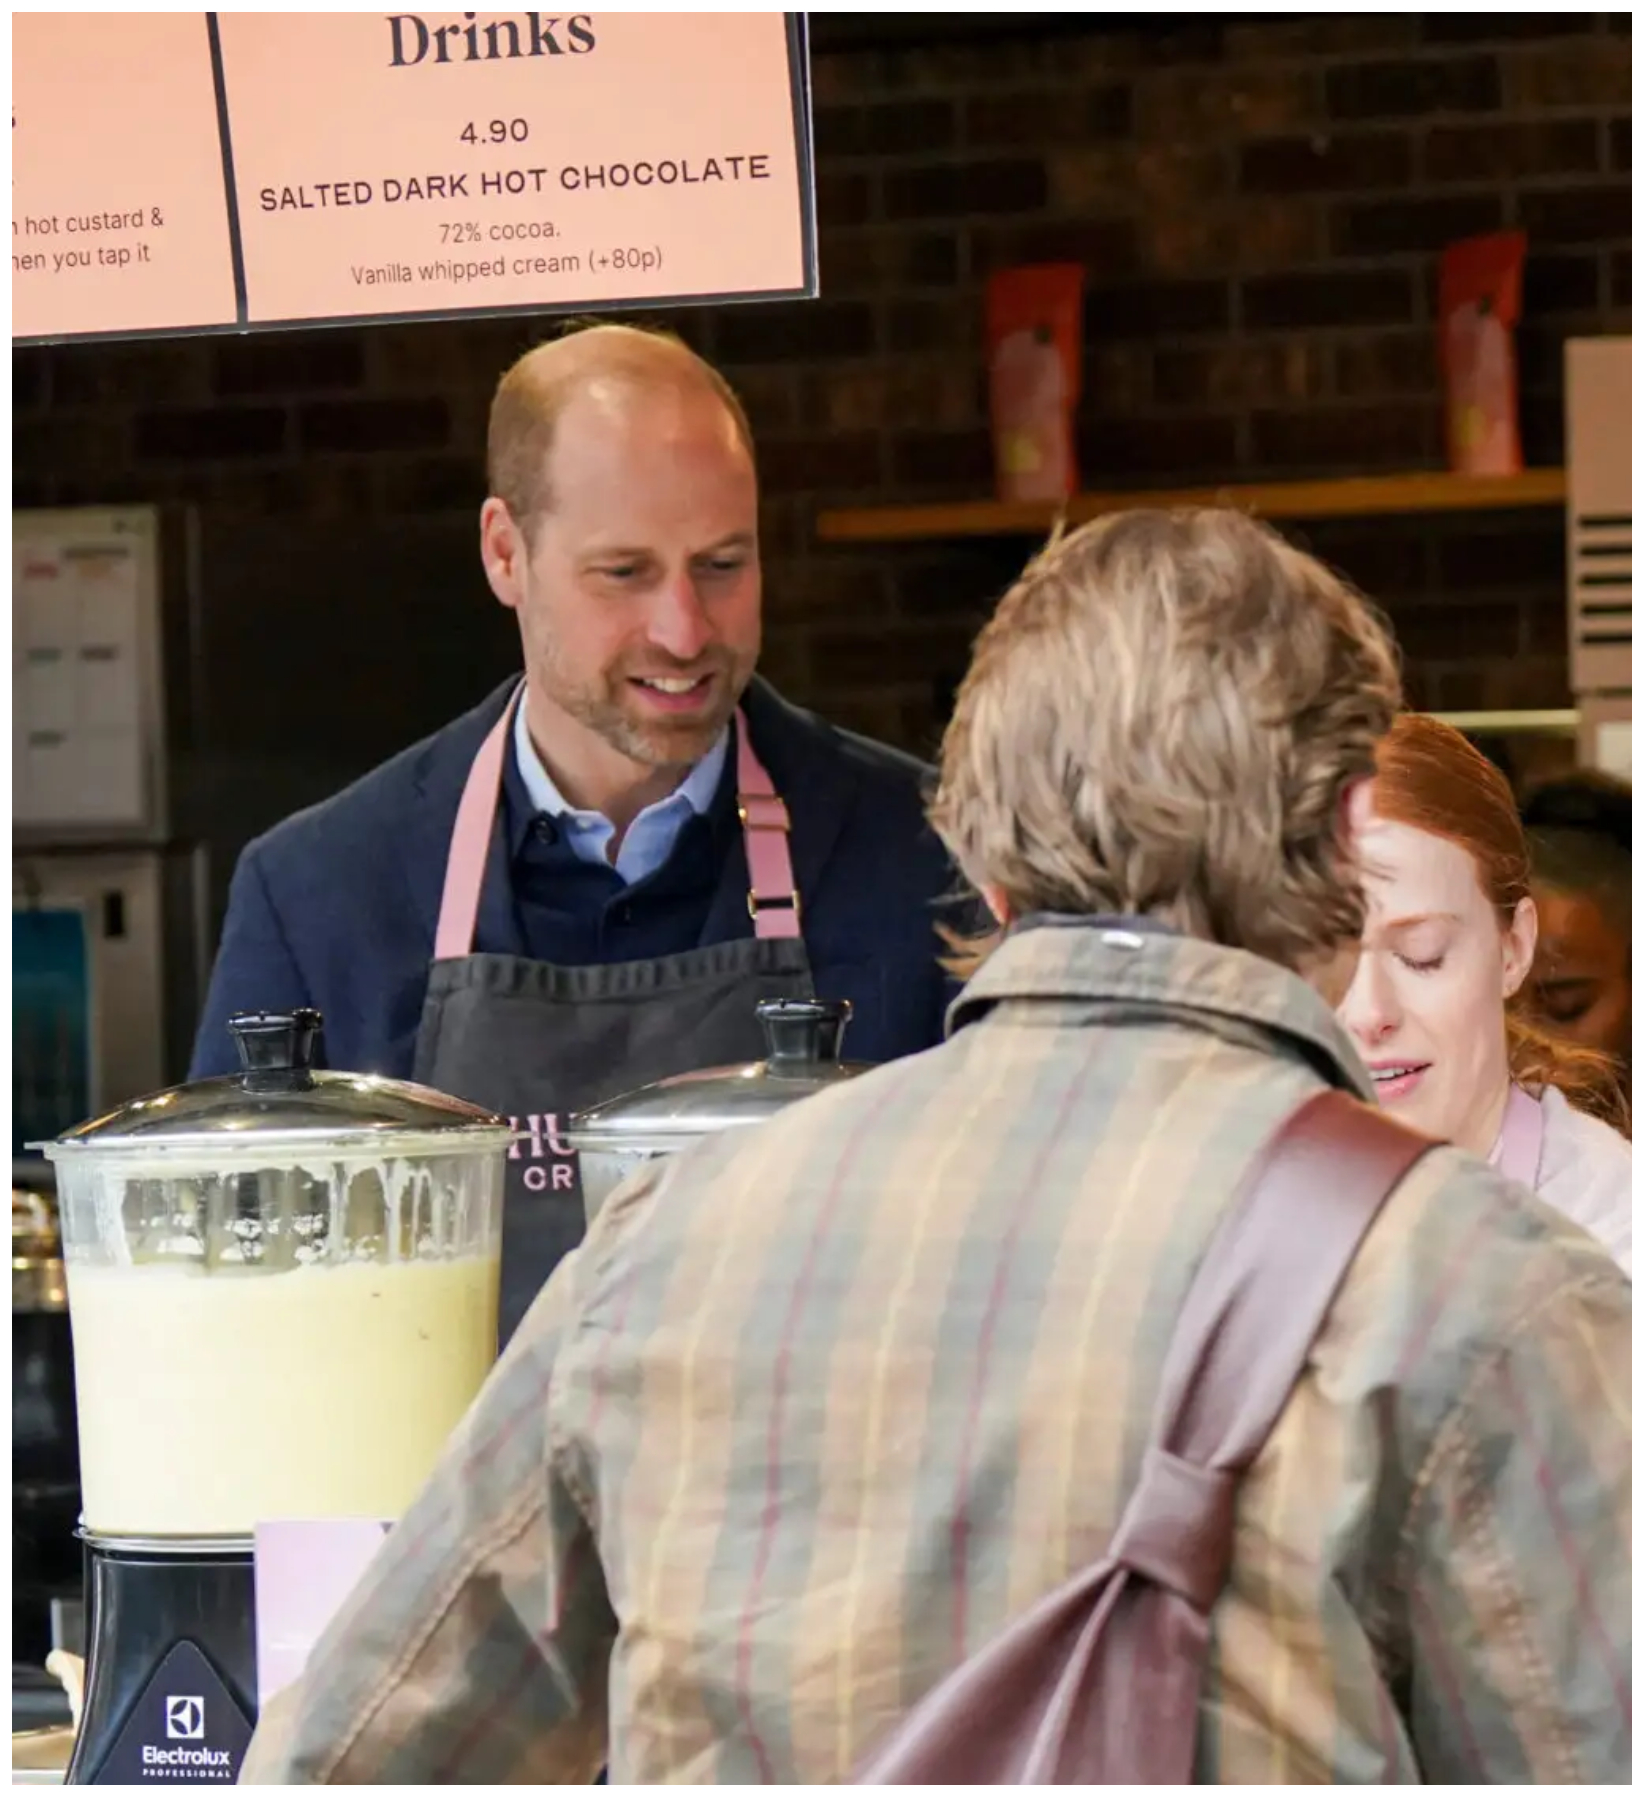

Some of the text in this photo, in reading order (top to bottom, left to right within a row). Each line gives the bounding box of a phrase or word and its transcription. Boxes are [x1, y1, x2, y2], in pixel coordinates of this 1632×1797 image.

[385, 12, 596, 67] Drinks
[459, 117, 529, 146] 4.90
[259, 154, 771, 212] SALTED DARK HOT CHOCOLATE
[25, 215, 60, 235] hot
[65, 208, 144, 233] custard
[151, 206, 164, 227] &
[439, 221, 561, 244] 72% cocoa.
[53, 251, 92, 274] you
[98, 246, 131, 268] tap
[137, 242, 151, 262] it
[350, 246, 663, 286] Vanilla whipped cream (+80p)
[142, 1745, 231, 1766] Electrolux
[142, 1768, 231, 1779] PROFESSIONAL
